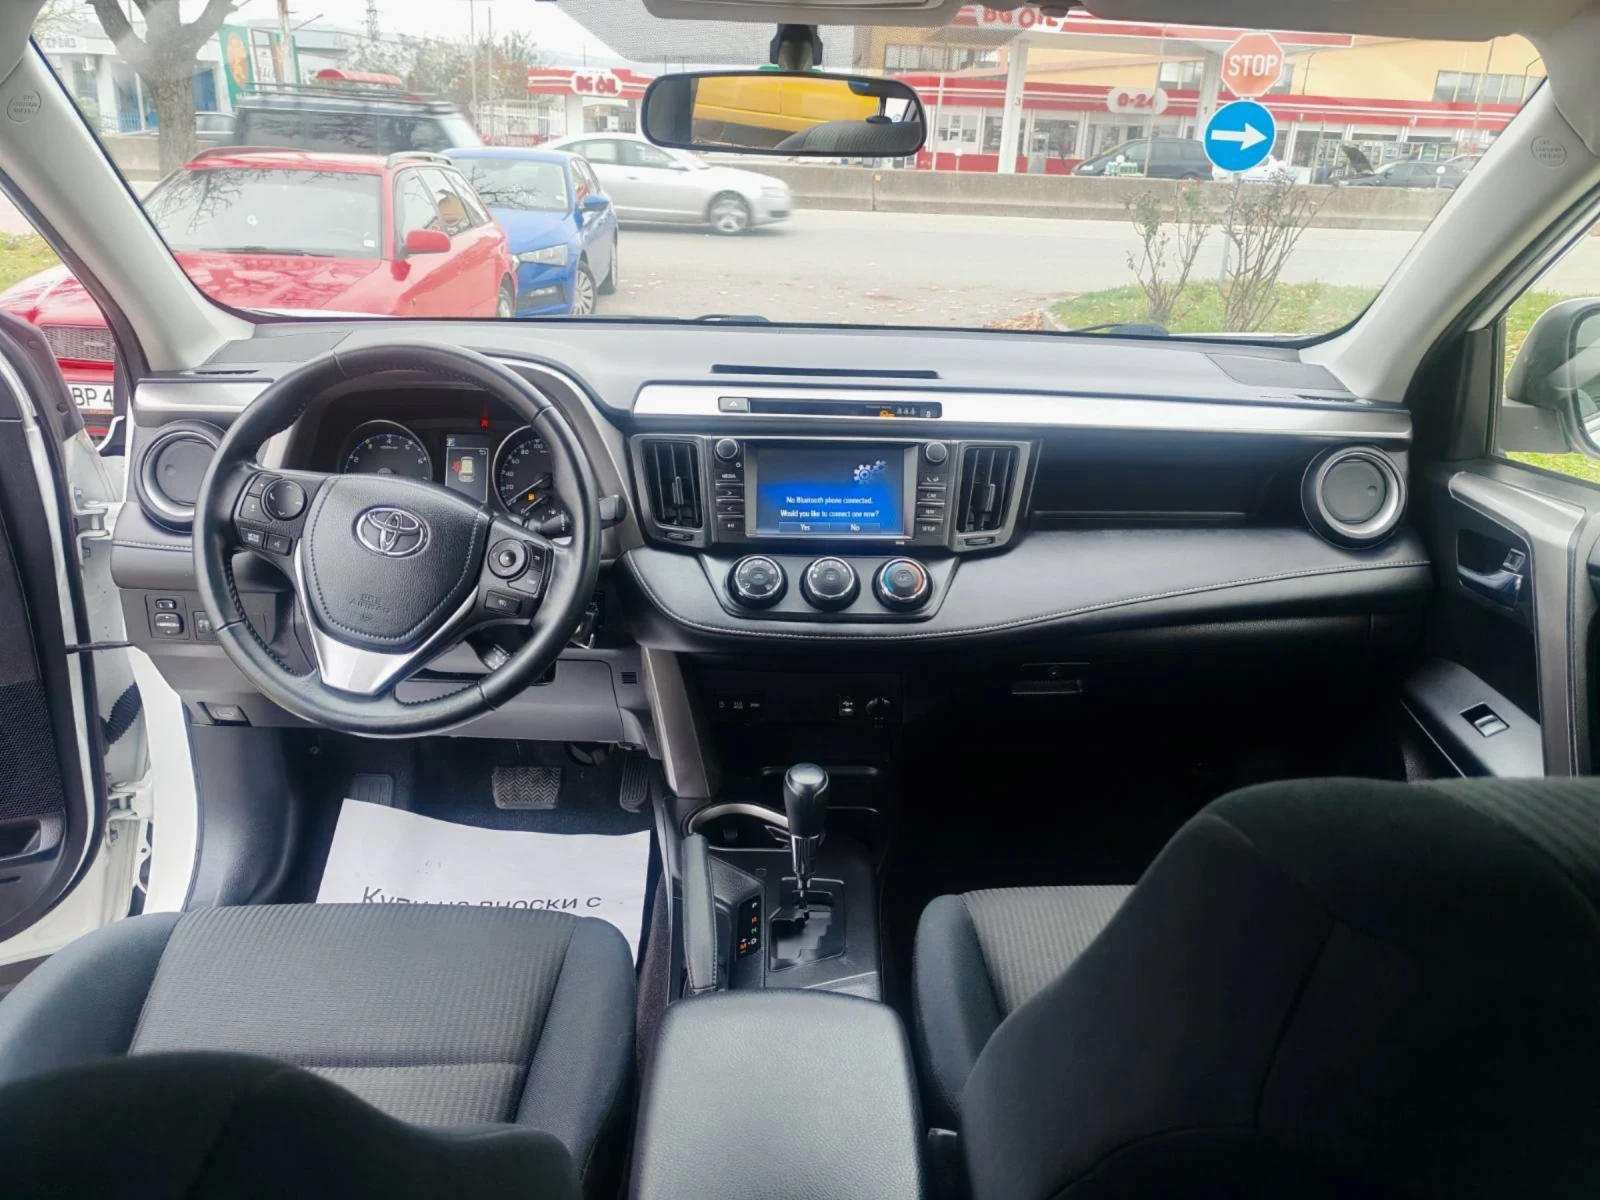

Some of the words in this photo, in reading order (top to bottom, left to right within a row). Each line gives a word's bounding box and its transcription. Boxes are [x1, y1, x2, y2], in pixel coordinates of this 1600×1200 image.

[1228, 54, 1278, 77] STOP
[786, 496, 796, 504] No
[796, 496, 824, 504] Bluetooth
[825, 496, 842, 505] phone
[780, 509, 798, 517] Would
[810, 509, 821, 517] like
[829, 510, 850, 518] connect
[801, 523, 811, 531] Yes
[850, 523, 860, 531] No
